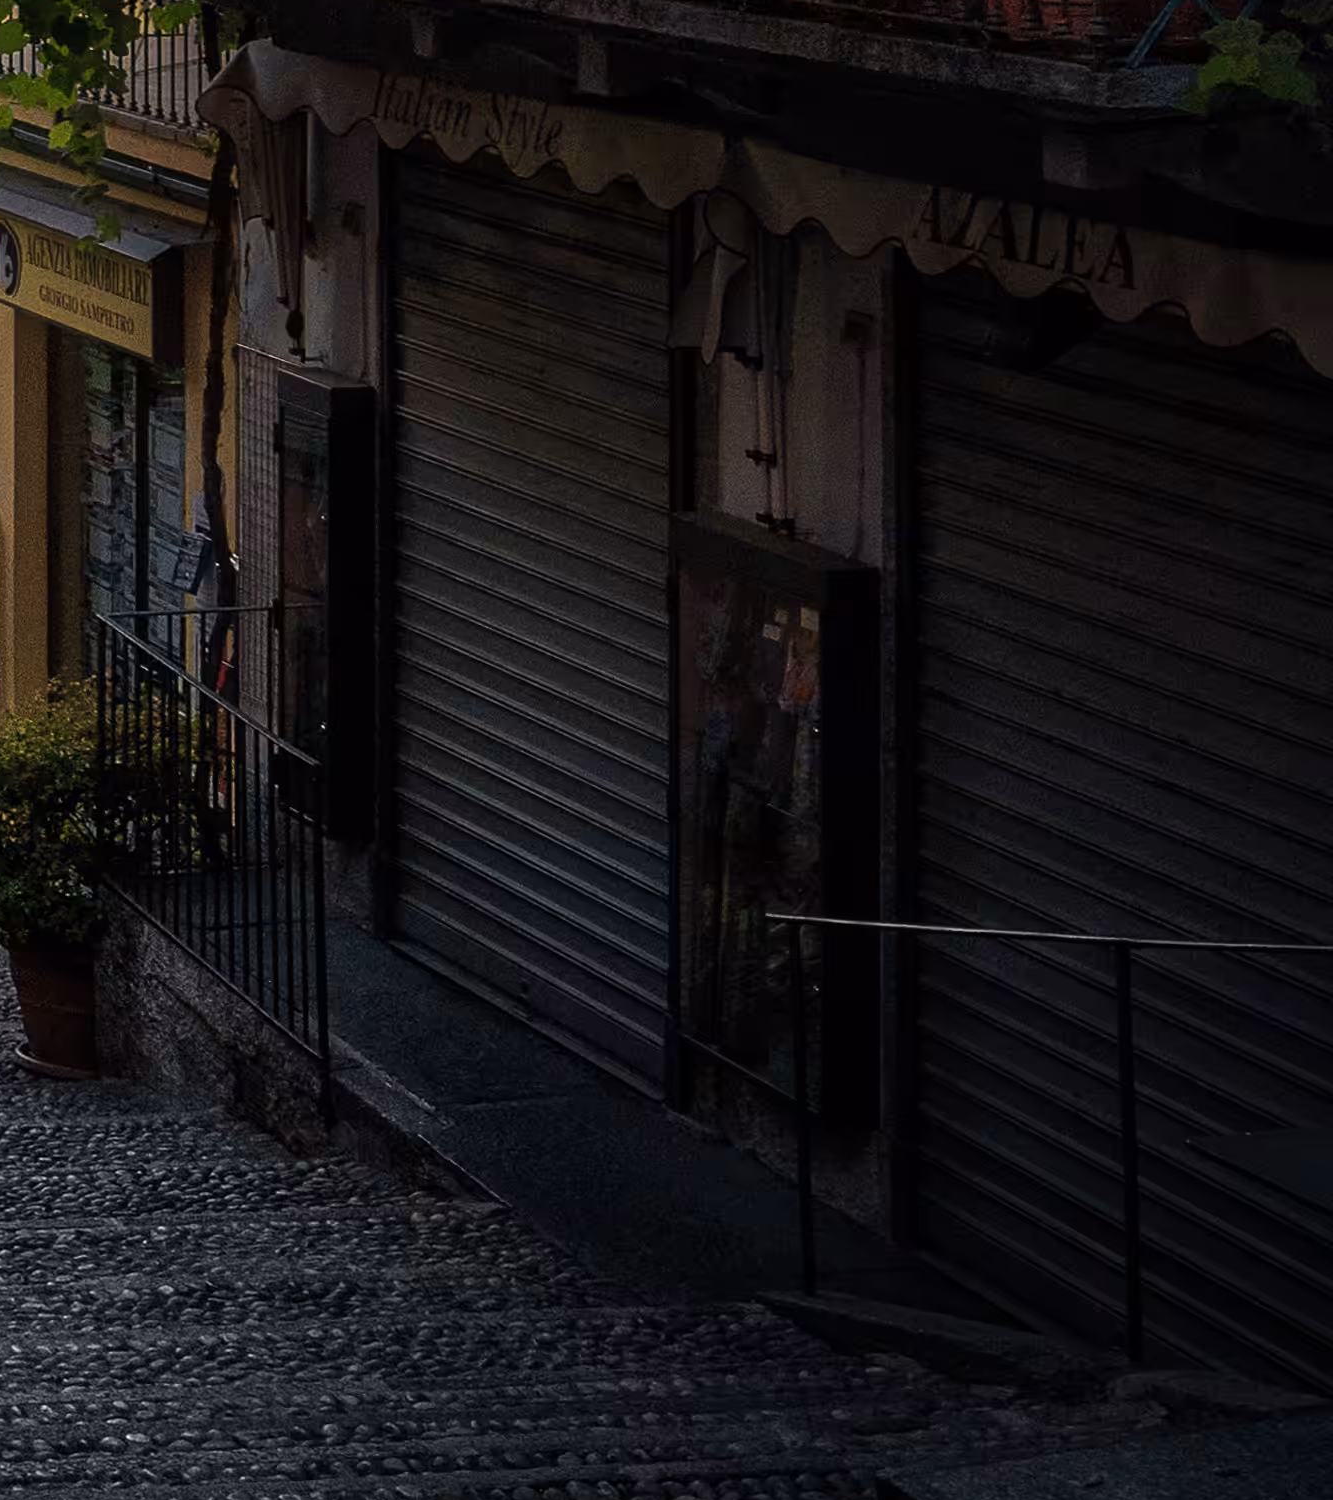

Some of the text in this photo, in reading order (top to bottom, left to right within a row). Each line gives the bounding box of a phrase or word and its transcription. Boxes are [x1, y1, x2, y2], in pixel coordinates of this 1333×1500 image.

[371, 72, 564, 170] Italian Style
[25, 233, 150, 307] AGENZIA IMMOBILIARE
[911, 187, 1138, 291] AZALEA
[38, 284, 135, 335] GIORGIO SAMPIETRO
